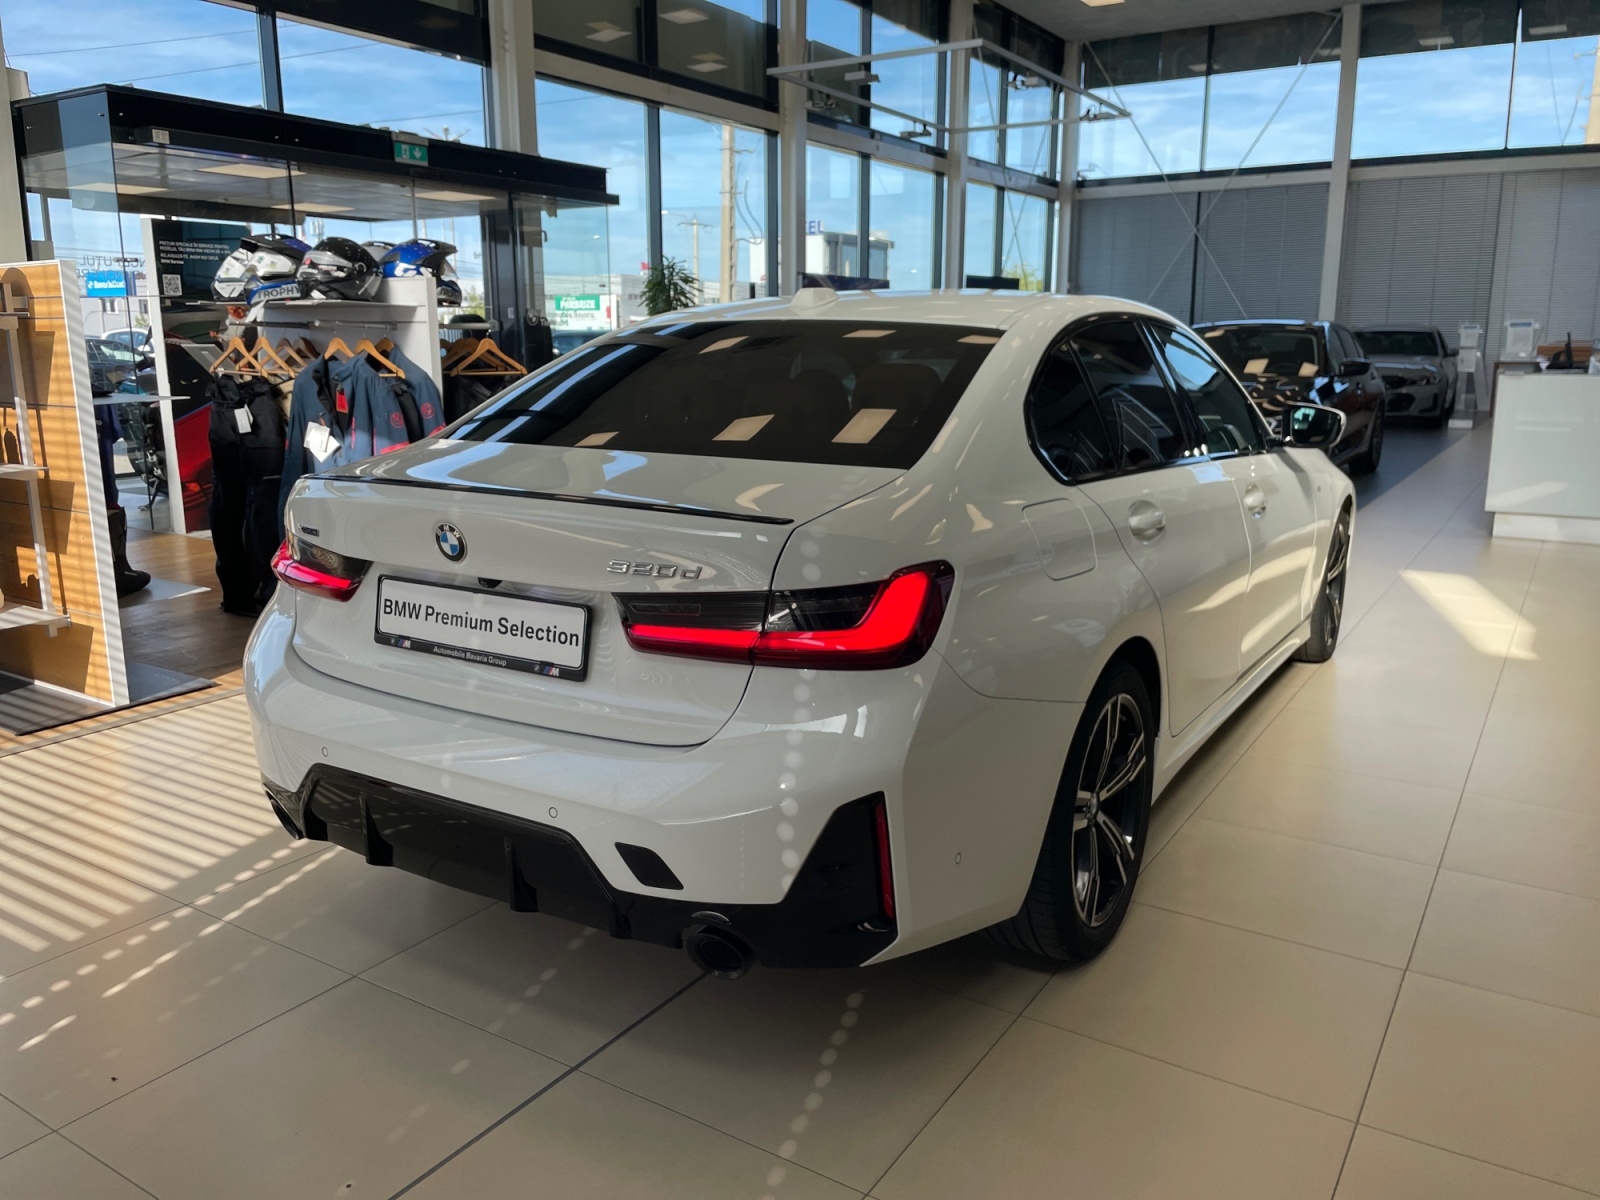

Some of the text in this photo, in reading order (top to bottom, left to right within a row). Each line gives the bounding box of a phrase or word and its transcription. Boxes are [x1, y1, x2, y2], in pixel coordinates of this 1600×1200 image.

[805, 220, 824, 235] EL
[606, 559, 703, 580] 320d
[383, 598, 579, 647] BMW Premium Selection
[433, 645, 507, 667] Automobile Bavaria Group
